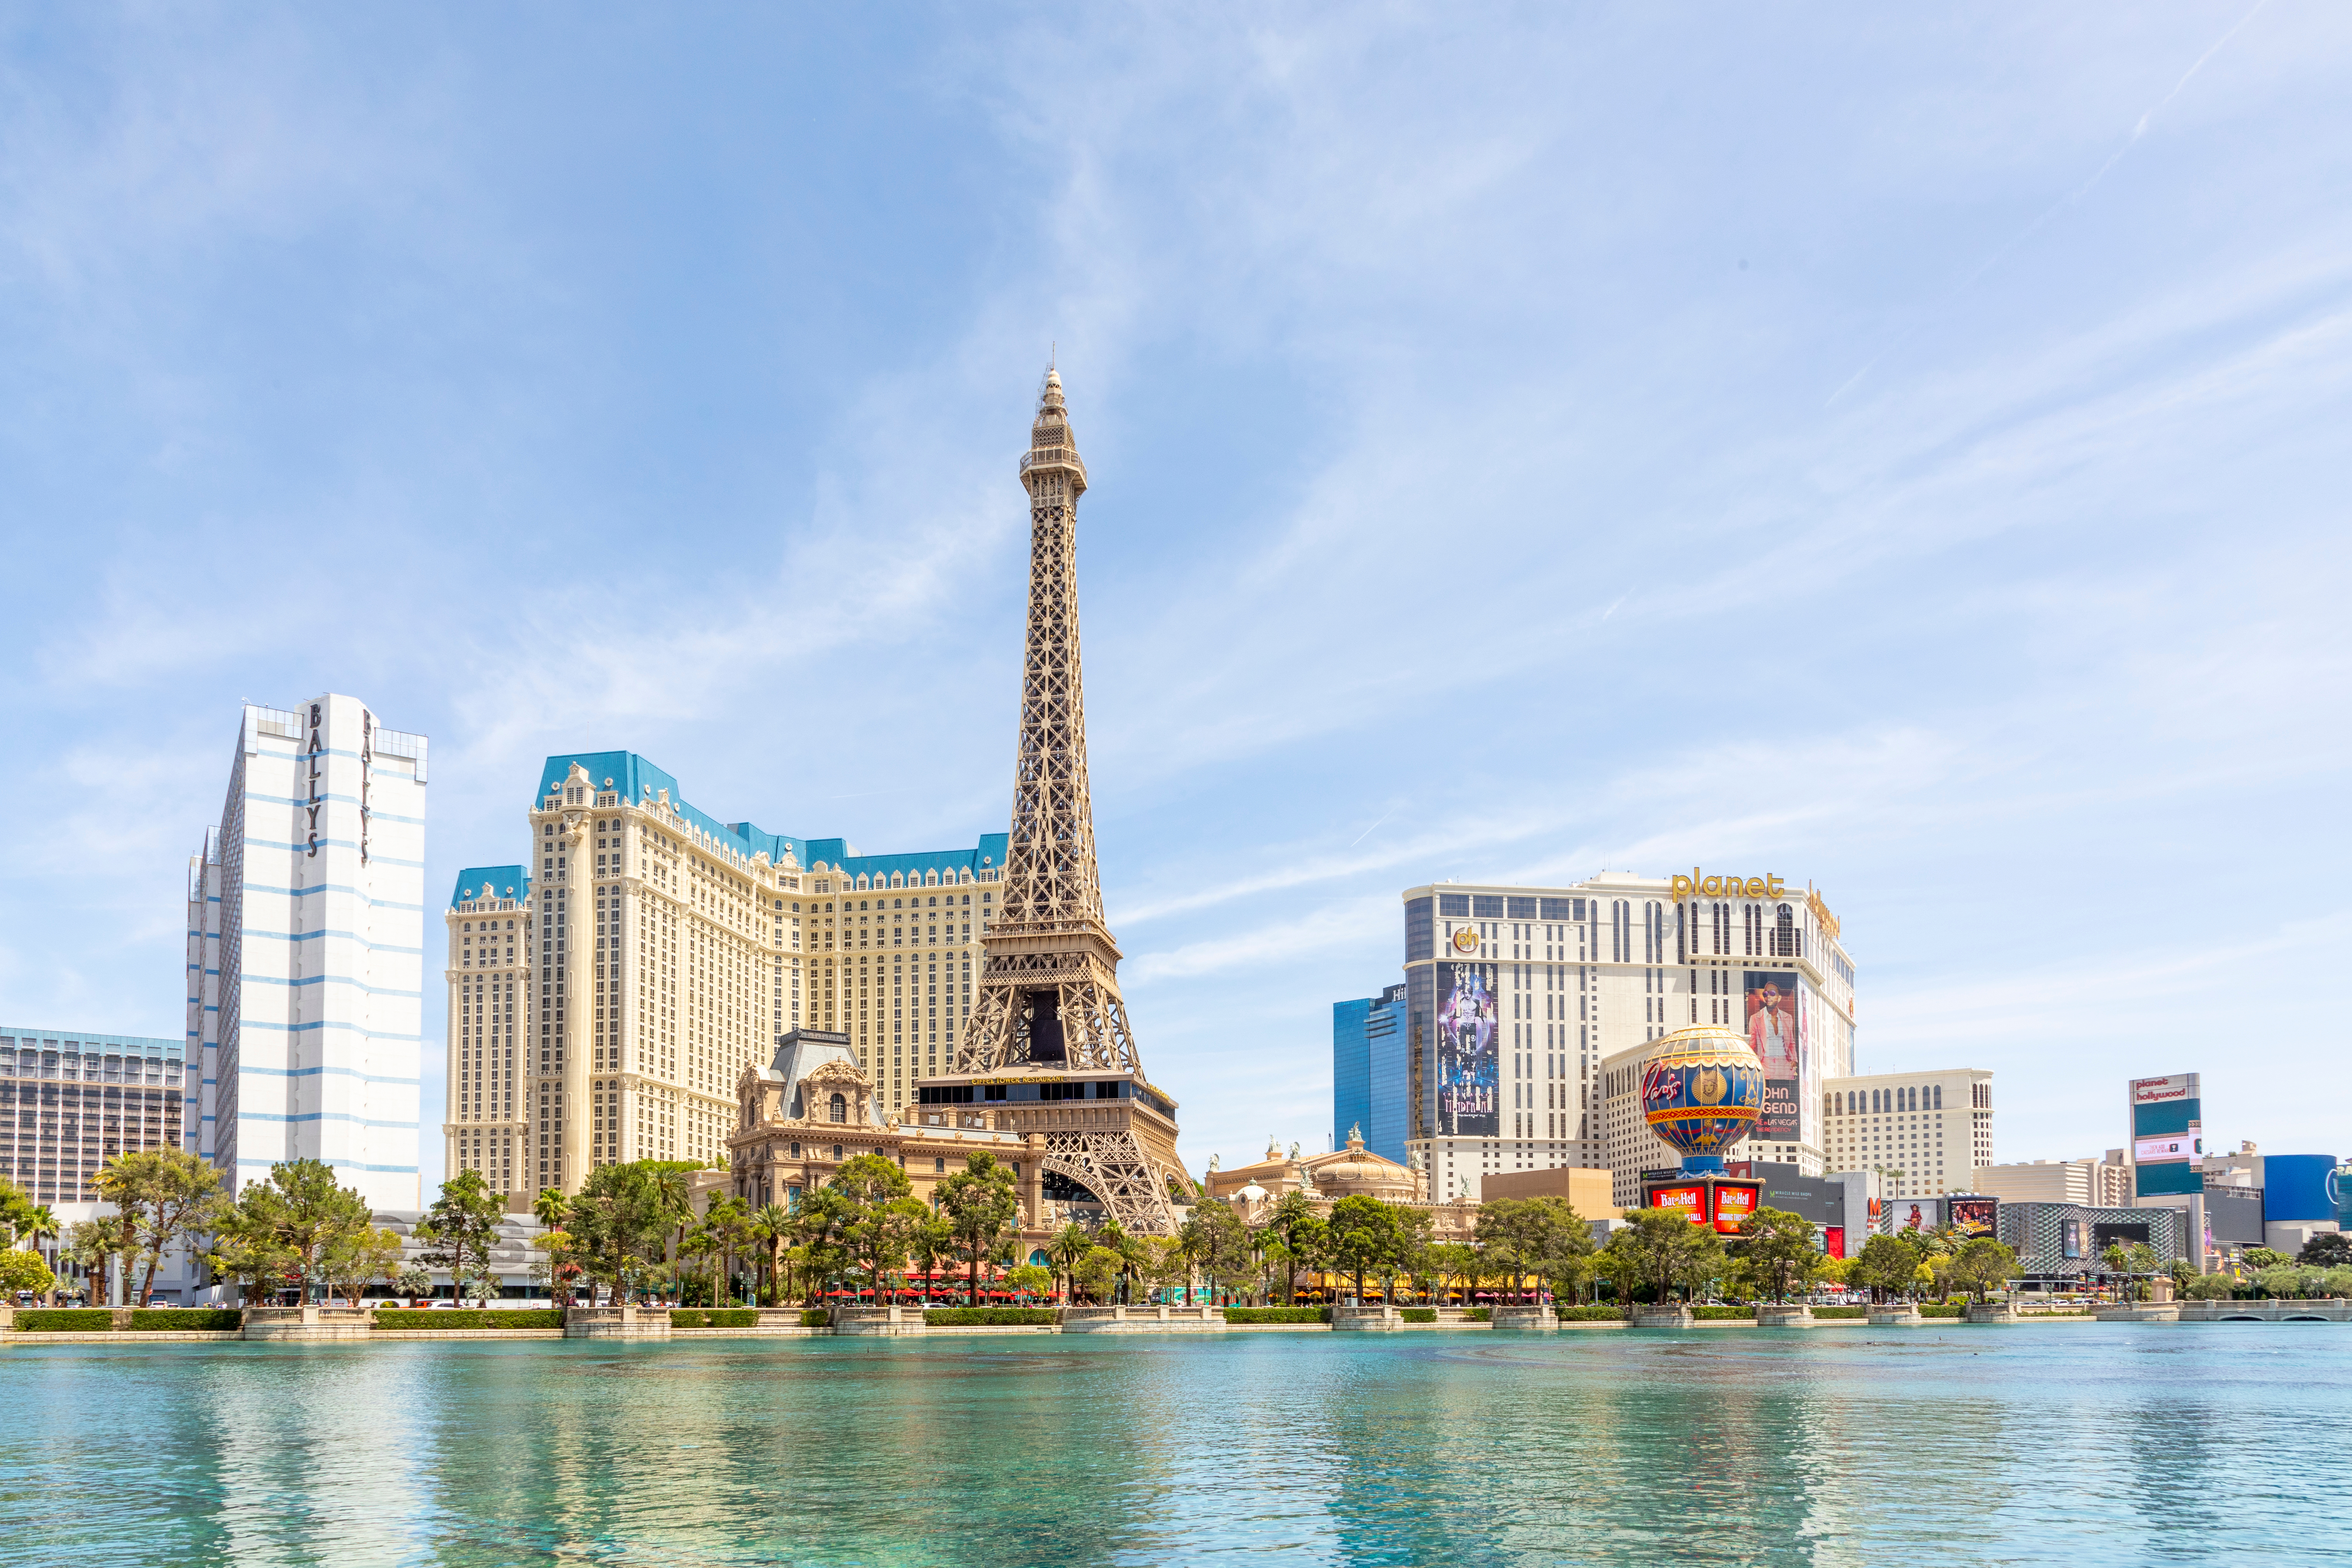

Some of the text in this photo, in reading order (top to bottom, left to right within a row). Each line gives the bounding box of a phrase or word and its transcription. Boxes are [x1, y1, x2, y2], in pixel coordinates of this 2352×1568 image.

[1672, 867, 1784, 903] planet
[1641, 1060, 1681, 1117] Paris
[2136, 1078, 2168, 1091] planet
[1765, 1087, 1789, 1099] OHN
[2137, 1088, 2185, 1101] hollywood
[1762, 1102, 1797, 1114] GEND
[1681, 1192, 1696, 1205] Hell
[1737, 1192, 1749, 1205] Hell
[1691, 1213, 1702, 1221] FALL
[1718, 1212, 1733, 1221] COMING
